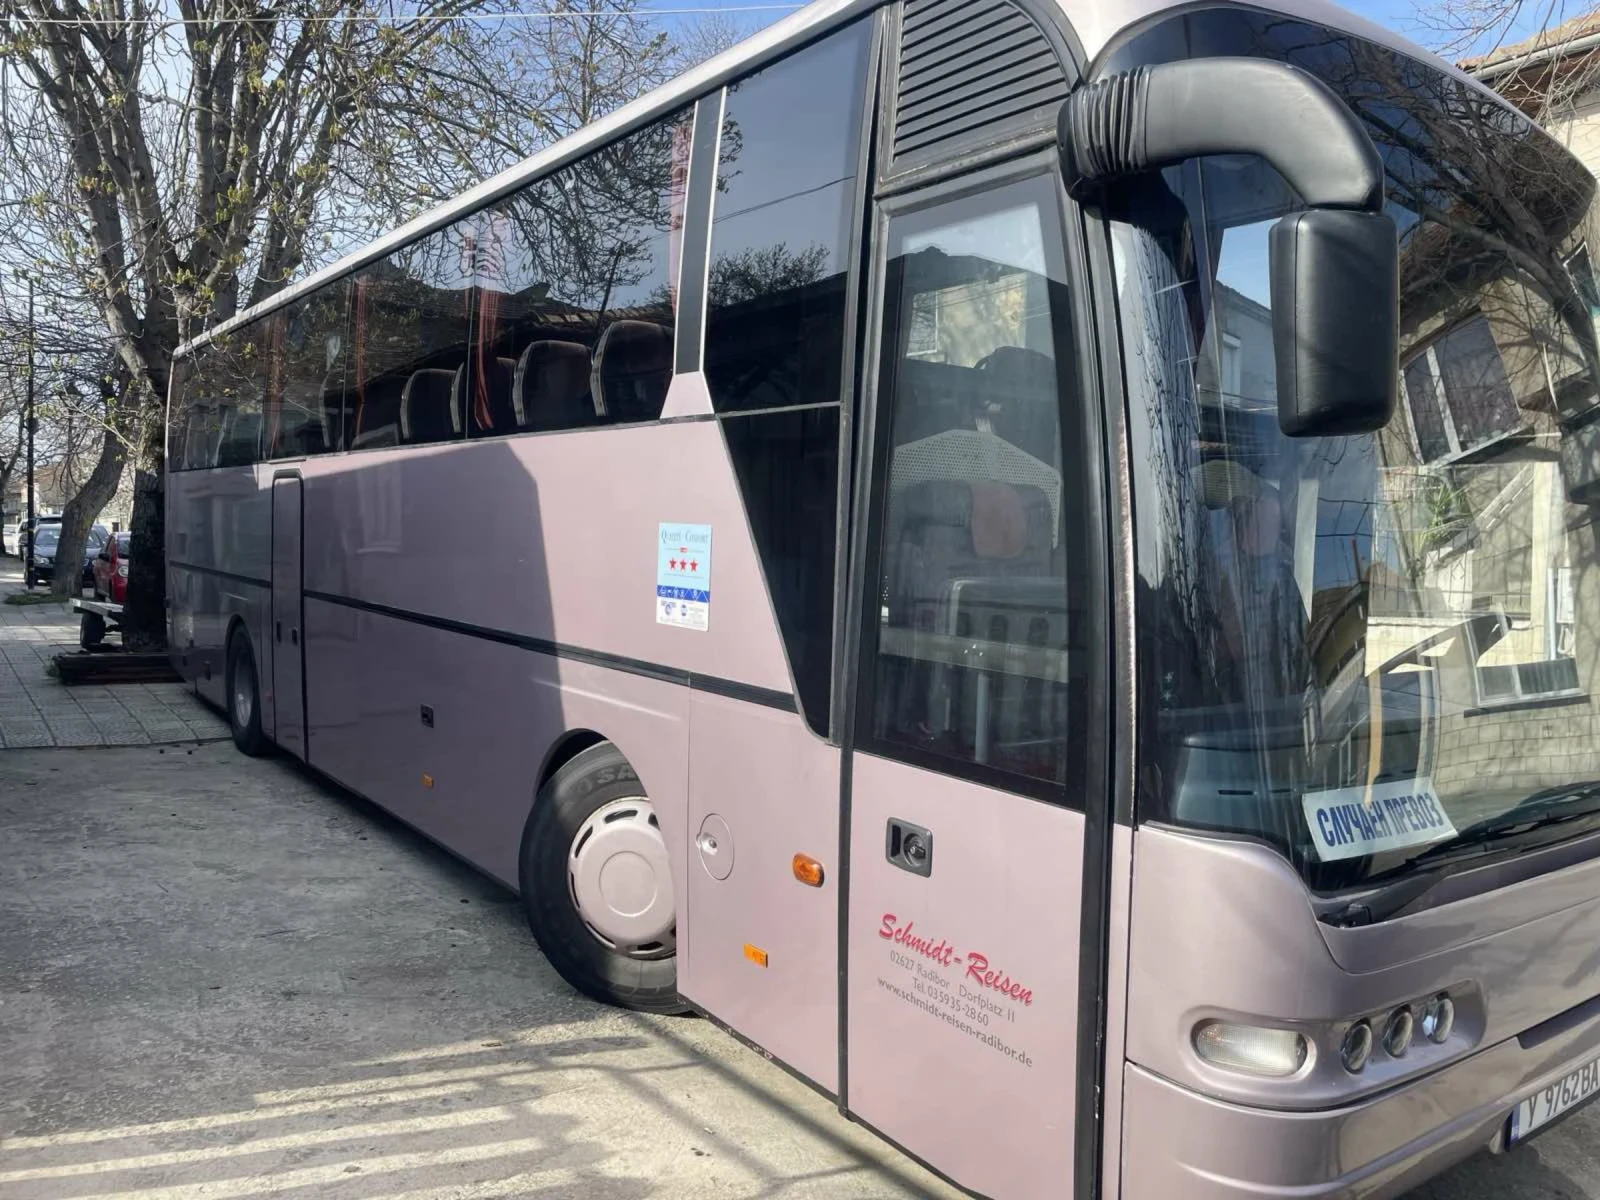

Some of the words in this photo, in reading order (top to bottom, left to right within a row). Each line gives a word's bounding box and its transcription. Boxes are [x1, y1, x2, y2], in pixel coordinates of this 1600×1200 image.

[1317, 802, 1393, 846] СЛУЧАЕН
[1384, 792, 1444, 835] ПРЕВОЗ
[890, 949, 915, 971] 02627
[917, 964, 950, 989] Radibor
[959, 984, 1003, 1017] Dorfplatz
[878, 976, 1033, 1068] www.schmidt-reisen-radibor.de
